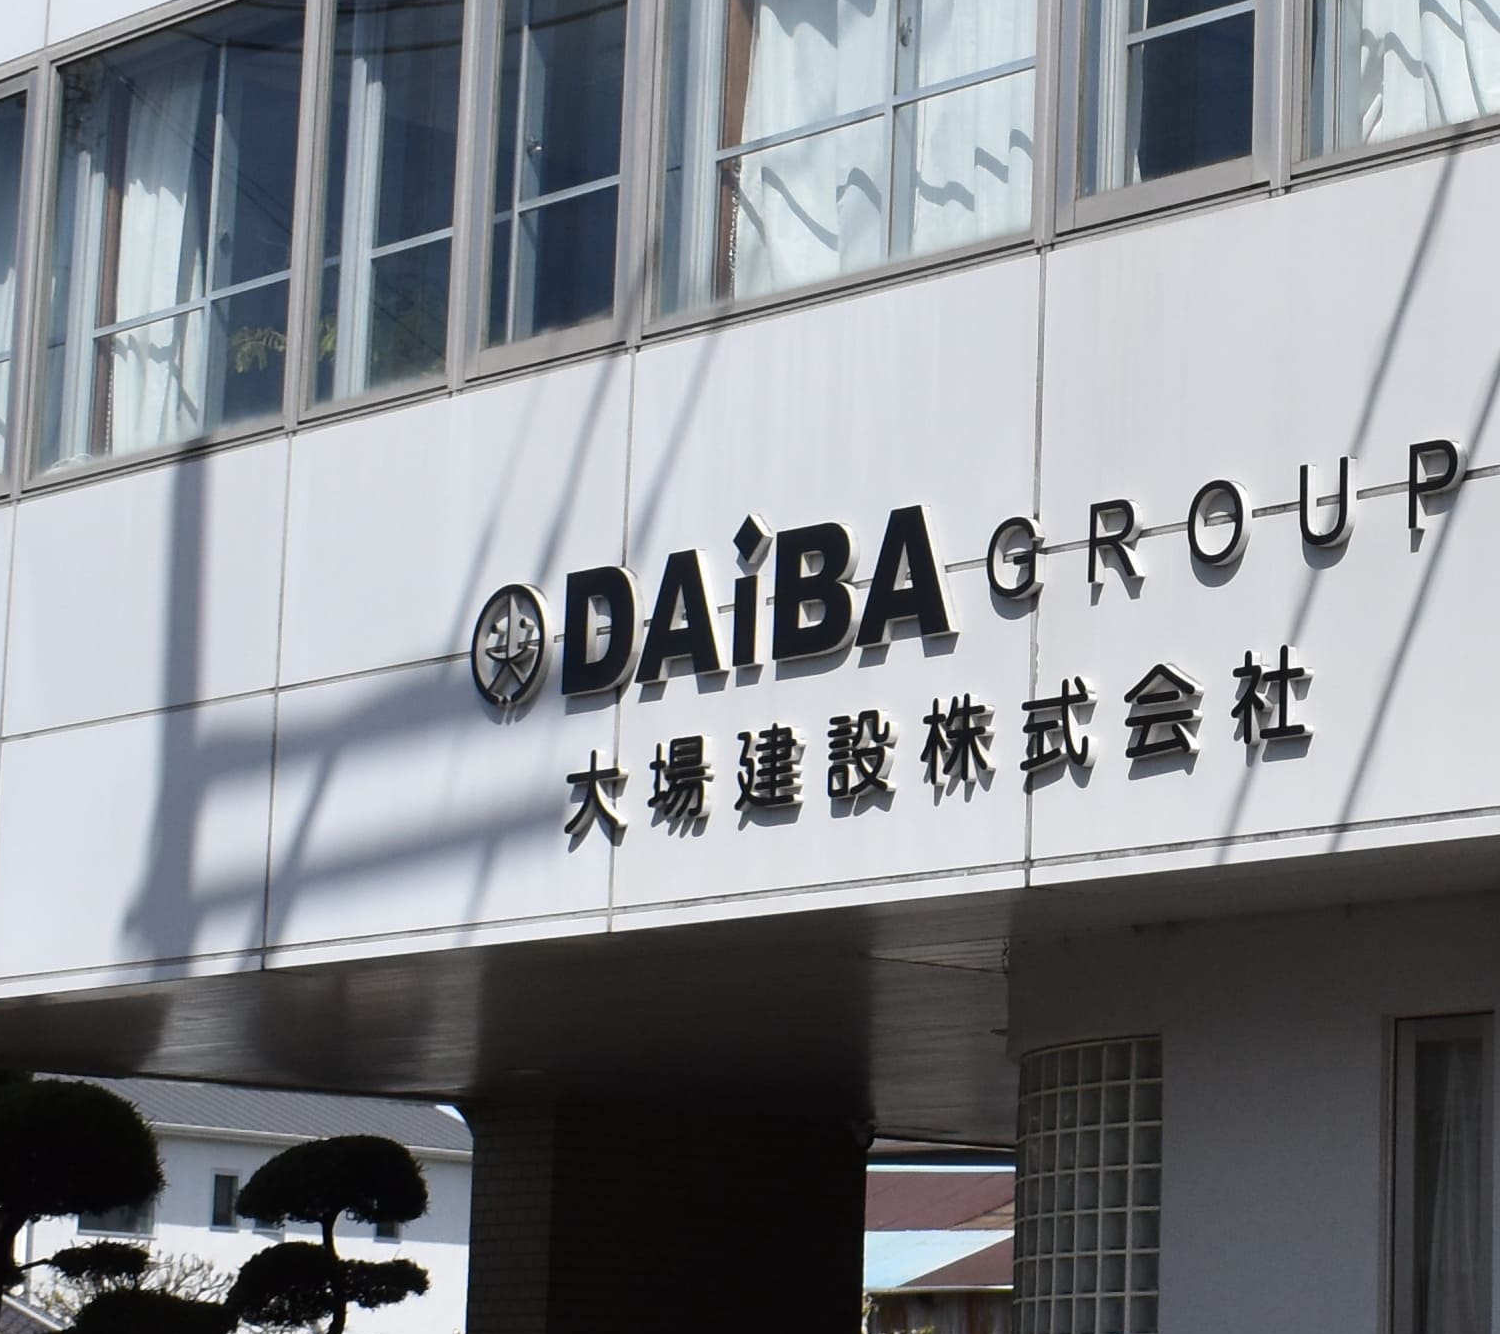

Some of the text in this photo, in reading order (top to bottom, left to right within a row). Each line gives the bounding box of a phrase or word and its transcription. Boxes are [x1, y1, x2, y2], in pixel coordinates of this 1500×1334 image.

[987, 438, 1467, 600] GROUP
[565, 644, 1313, 841] 大場建設株式会社
